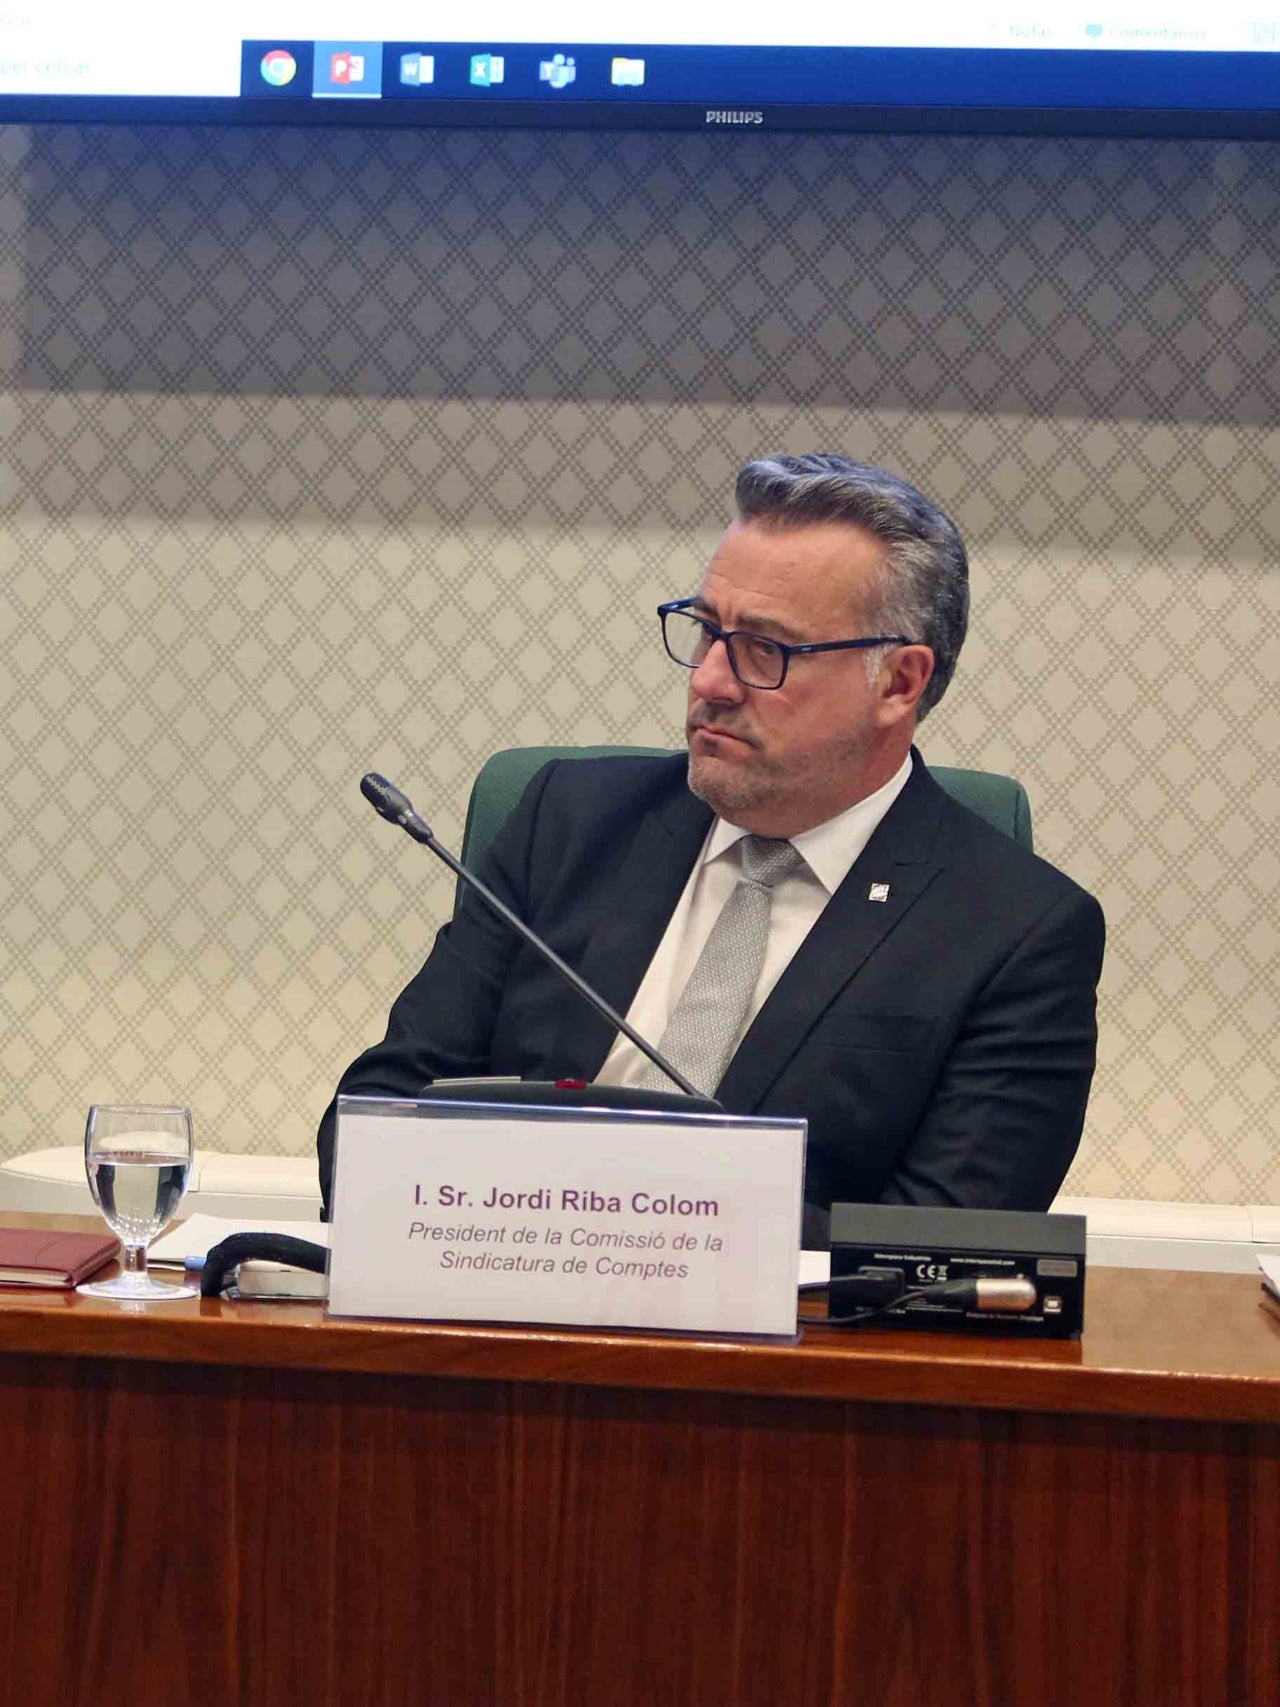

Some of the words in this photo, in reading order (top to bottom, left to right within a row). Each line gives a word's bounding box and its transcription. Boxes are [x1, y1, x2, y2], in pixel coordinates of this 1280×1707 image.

[705, 111, 764, 124] PHILIPS
[414, 1184, 428, 1206] I.
[438, 1185, 473, 1207] Sr.
[483, 1187, 552, 1210] Jordi
[561, 1190, 621, 1213] Riba
[631, 1192, 719, 1217] Colom
[408, 1222, 506, 1243] President
[512, 1226, 538, 1244] de
[544, 1227, 563, 1245] la
[570, 1228, 666, 1250] Comissió
[672, 1232, 698, 1250] de
[704, 1234, 723, 1252] la
[439, 1250, 556, 1273] Sindicatura
[562, 1256, 588, 1274] de
[595, 1256, 690, 1281] Comptes
[916, 1264, 936, 1279] CE
